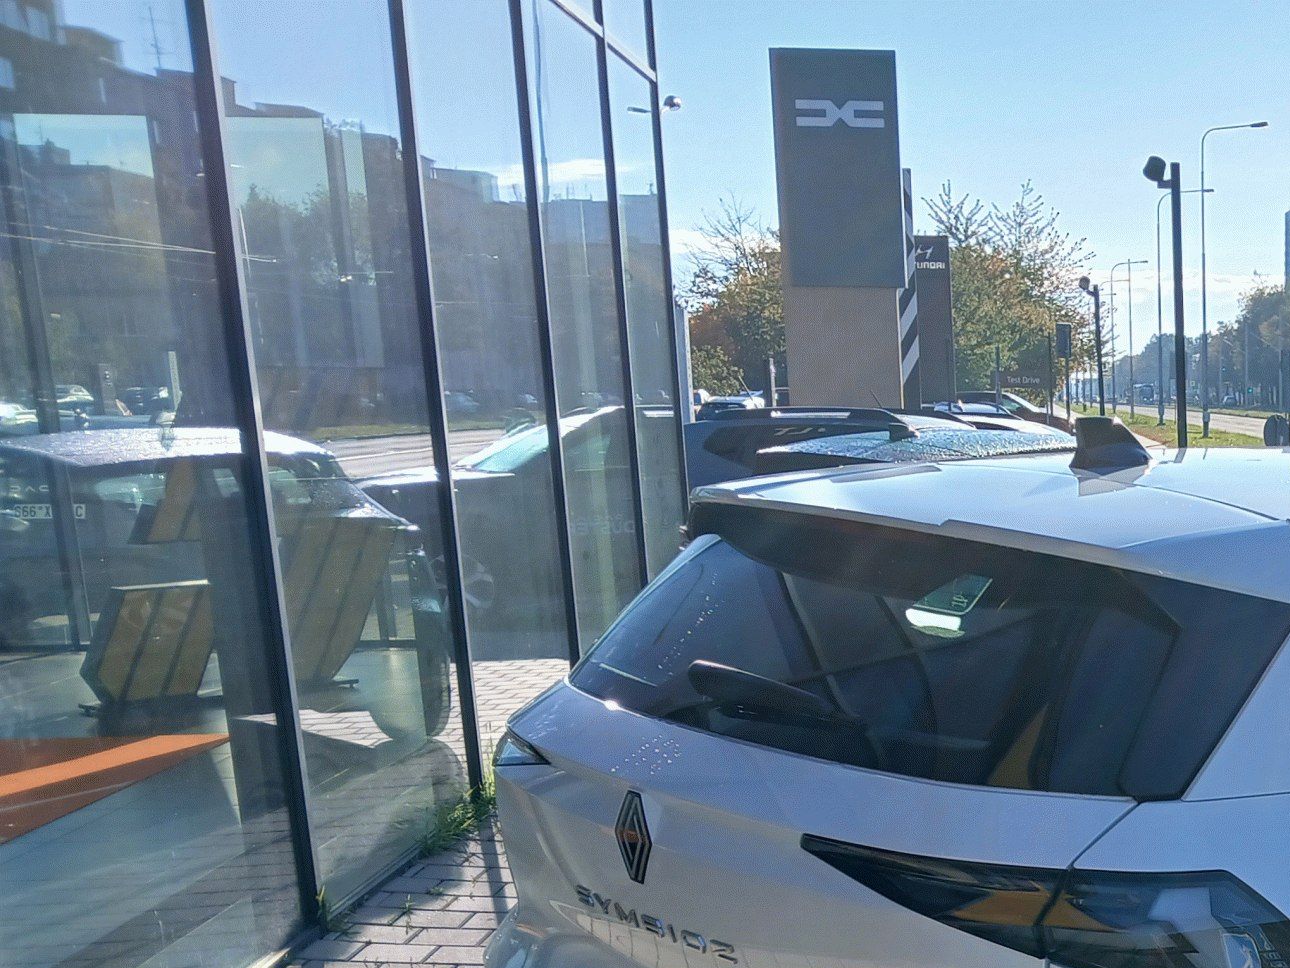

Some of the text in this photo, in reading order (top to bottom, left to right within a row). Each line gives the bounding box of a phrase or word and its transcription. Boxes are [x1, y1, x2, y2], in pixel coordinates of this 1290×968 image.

[1006, 375, 1041, 384] Test Drive
[575, 884, 739, 965] SYMBIOZ
